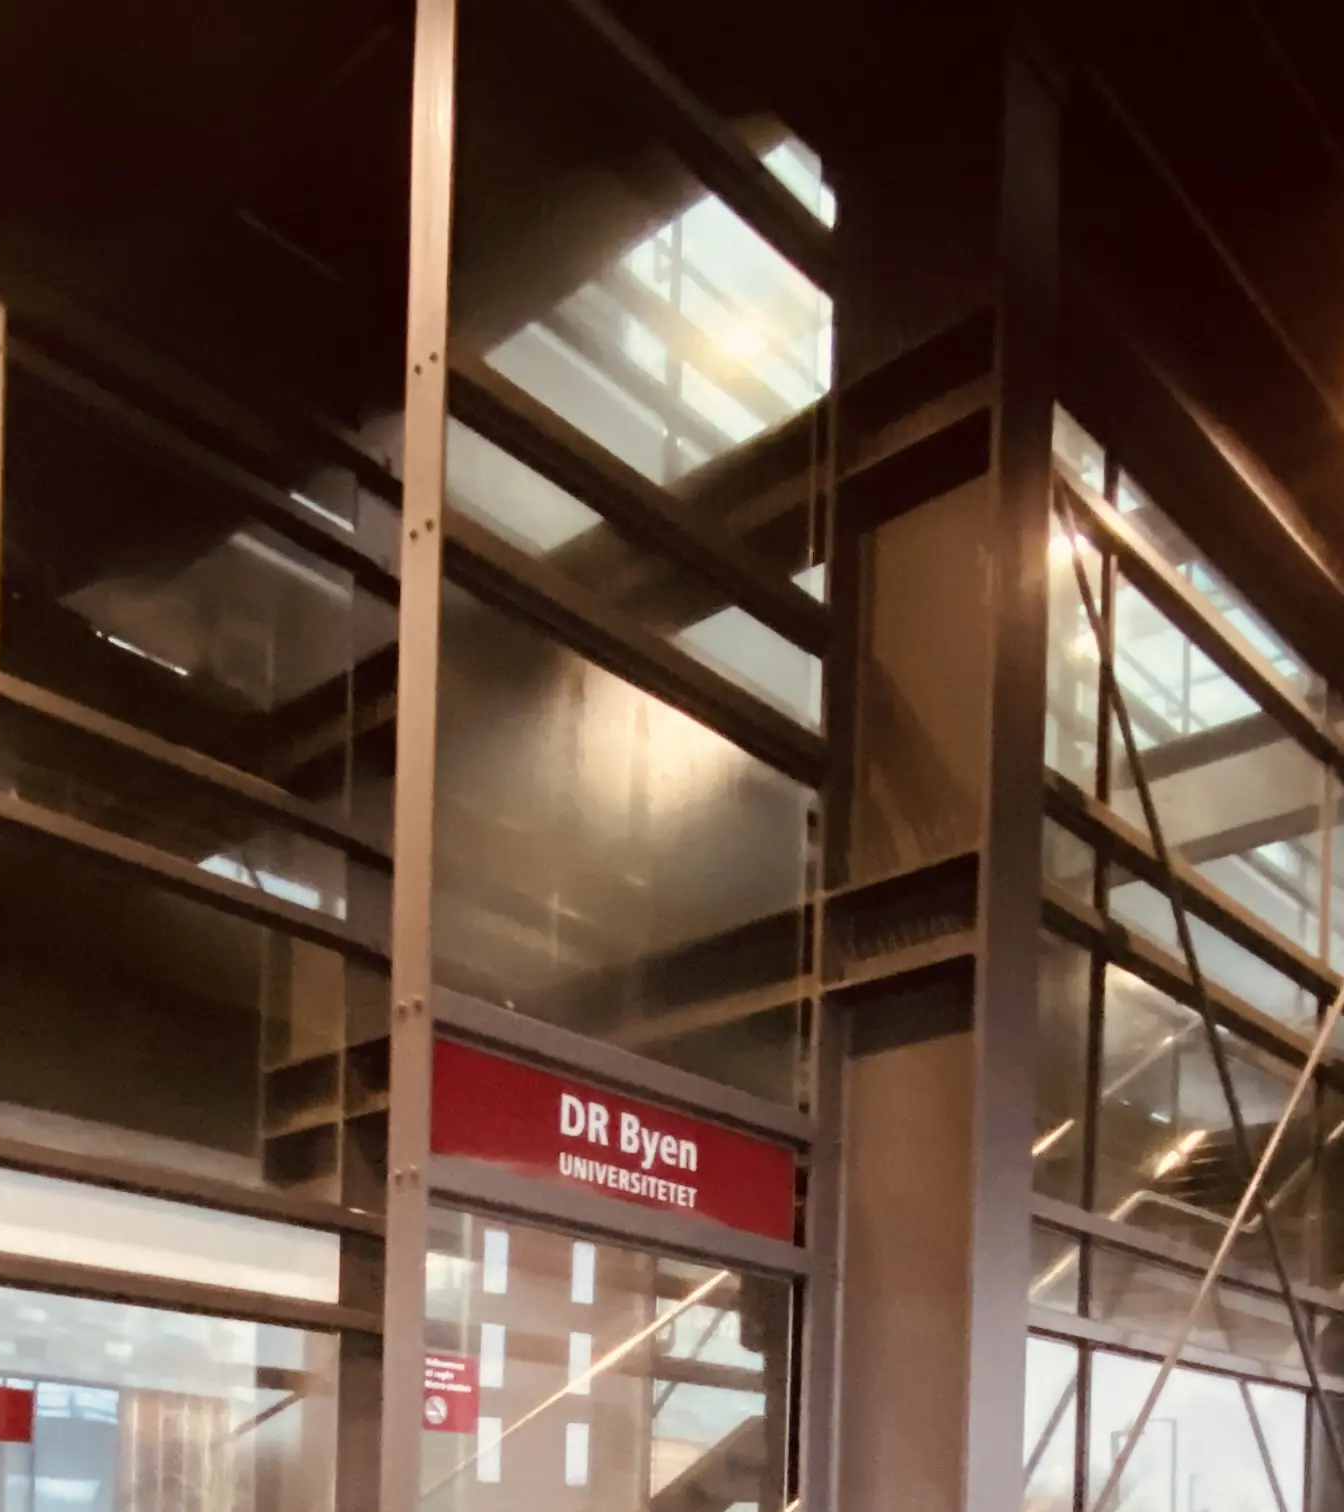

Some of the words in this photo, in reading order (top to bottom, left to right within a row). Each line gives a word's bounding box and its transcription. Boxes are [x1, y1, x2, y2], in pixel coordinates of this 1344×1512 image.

[559, 1093, 609, 1146] DR
[620, 1111, 698, 1172] Byen
[559, 1152, 698, 1208] UNIVERSITETET
